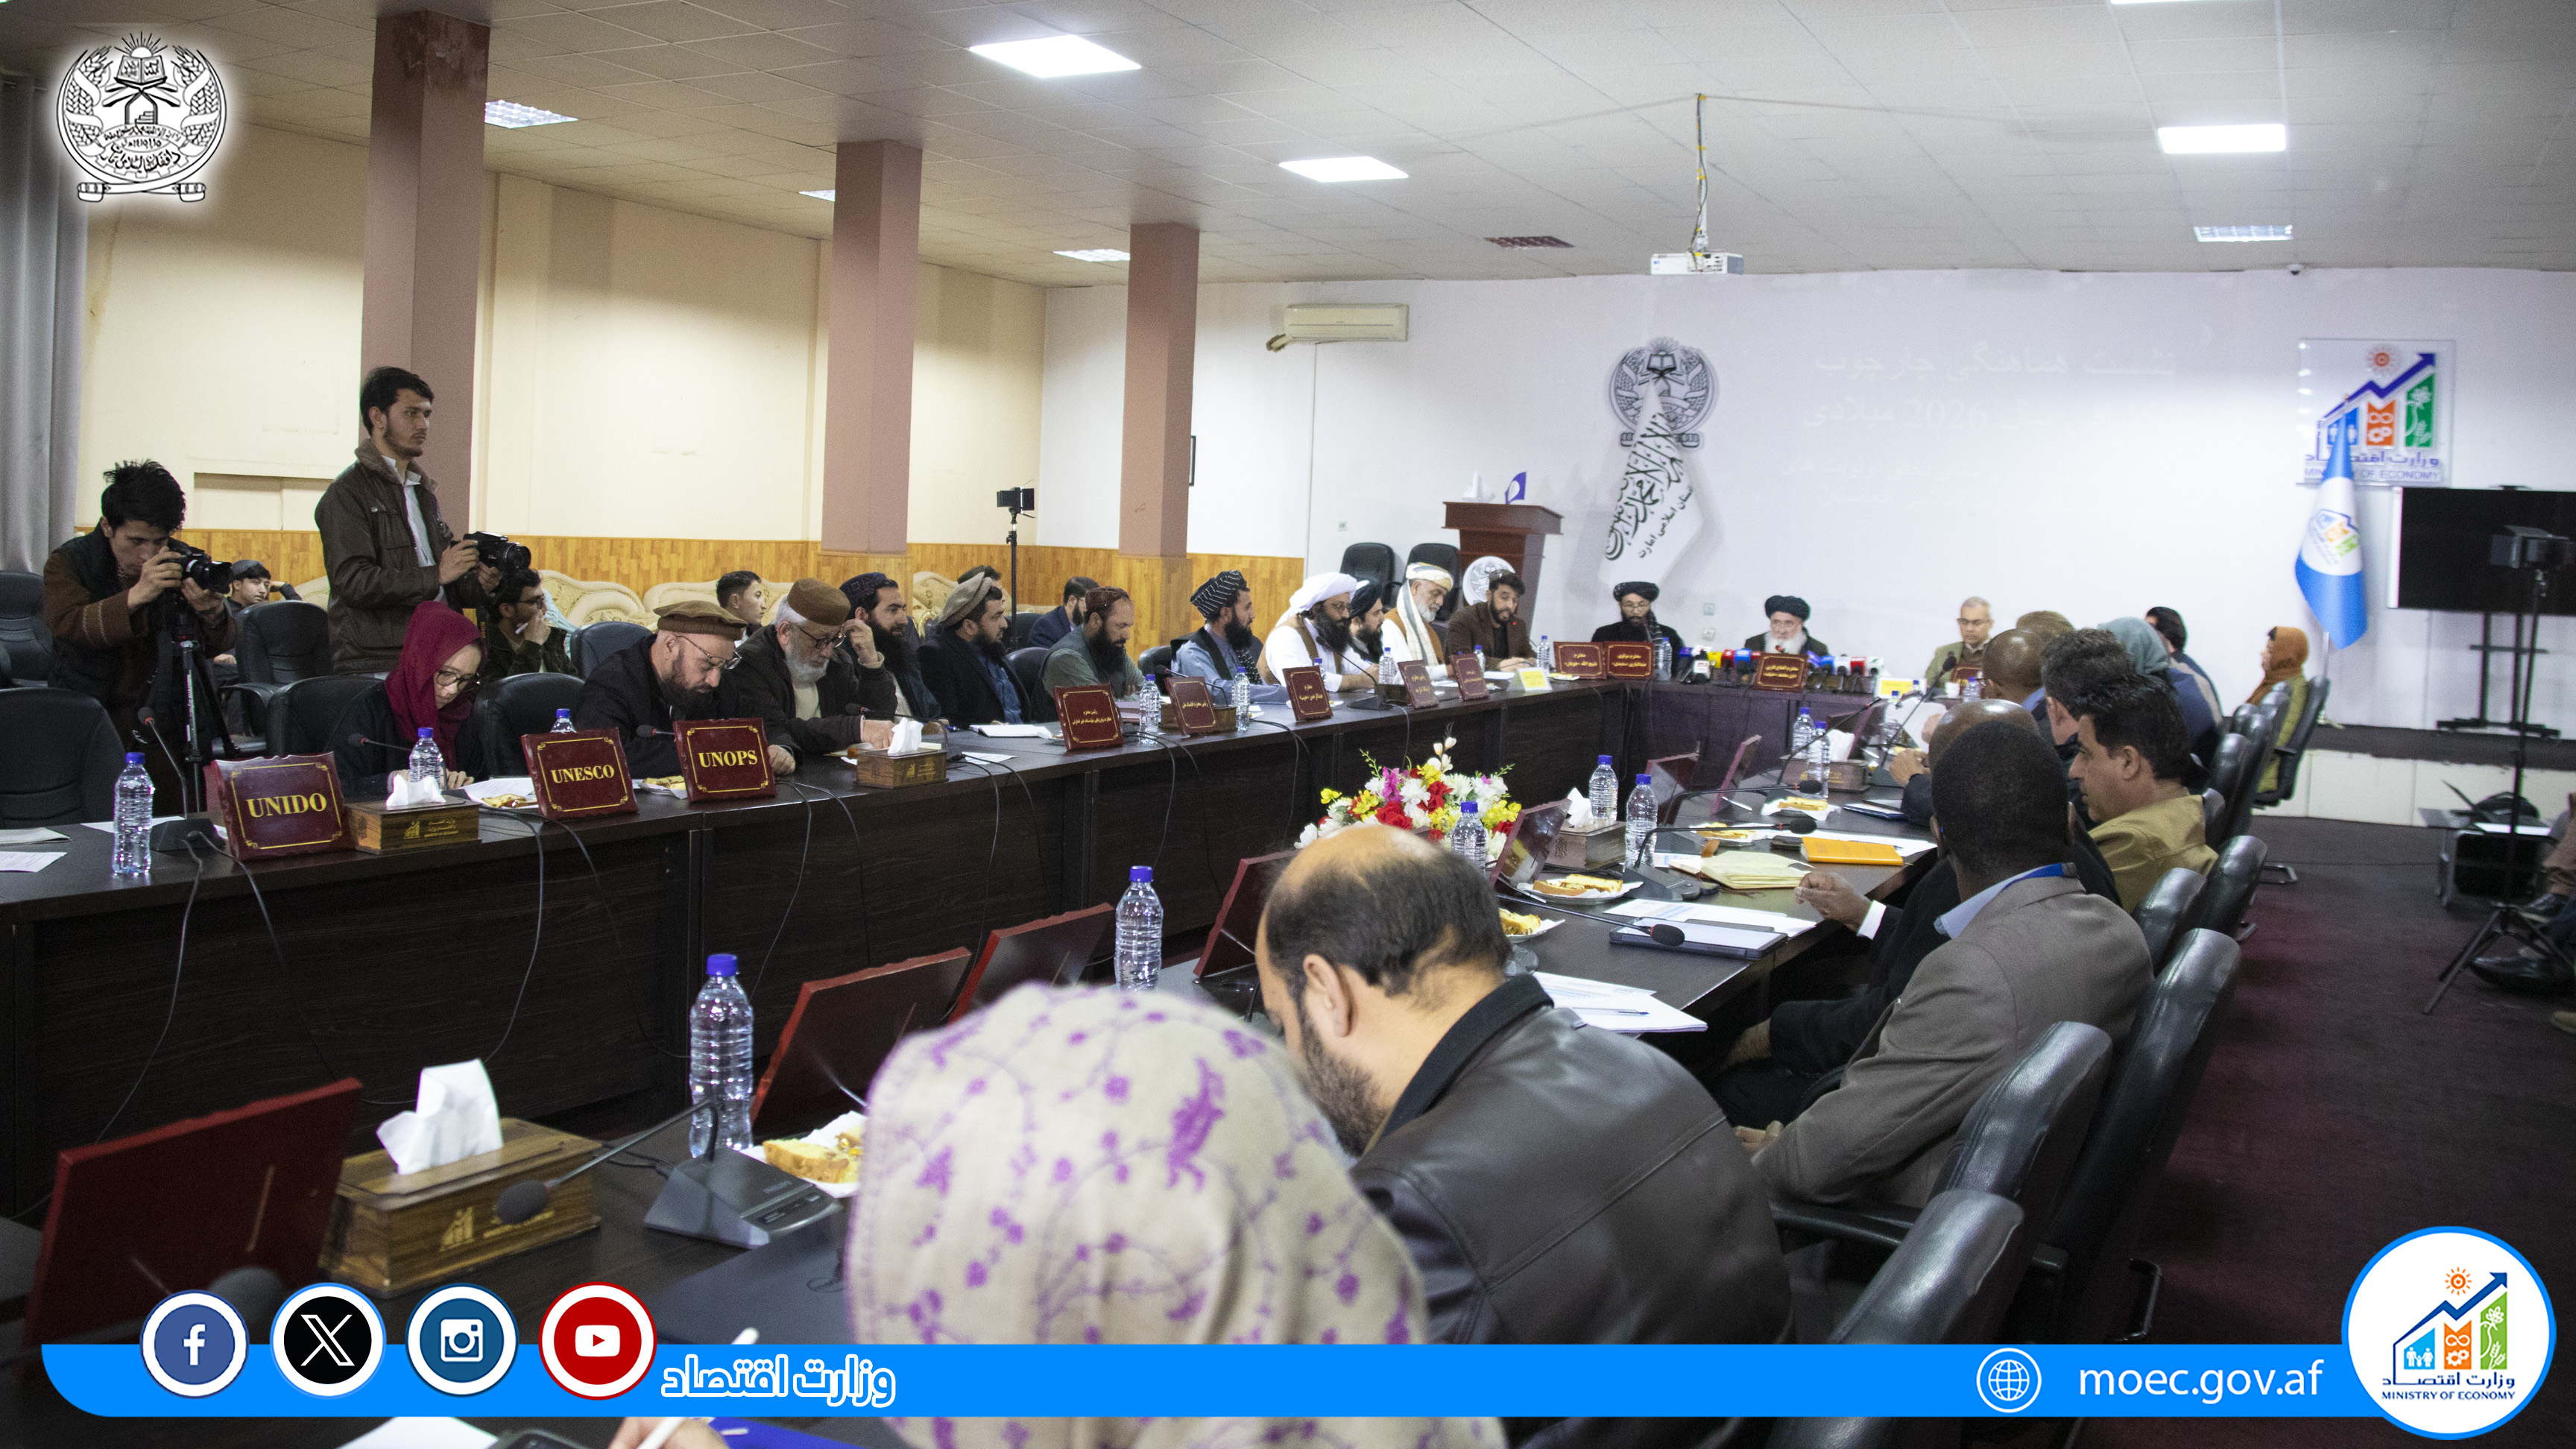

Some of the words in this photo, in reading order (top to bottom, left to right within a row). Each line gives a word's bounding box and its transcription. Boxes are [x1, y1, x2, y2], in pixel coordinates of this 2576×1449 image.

[1904, 399, 1989, 430] 2026
[2379, 470, 2440, 479] ECONOMY
[698, 750, 758, 768] UNOPS
[550, 764, 615, 784] UNESCO
[245, 792, 327, 818] UNIDO
